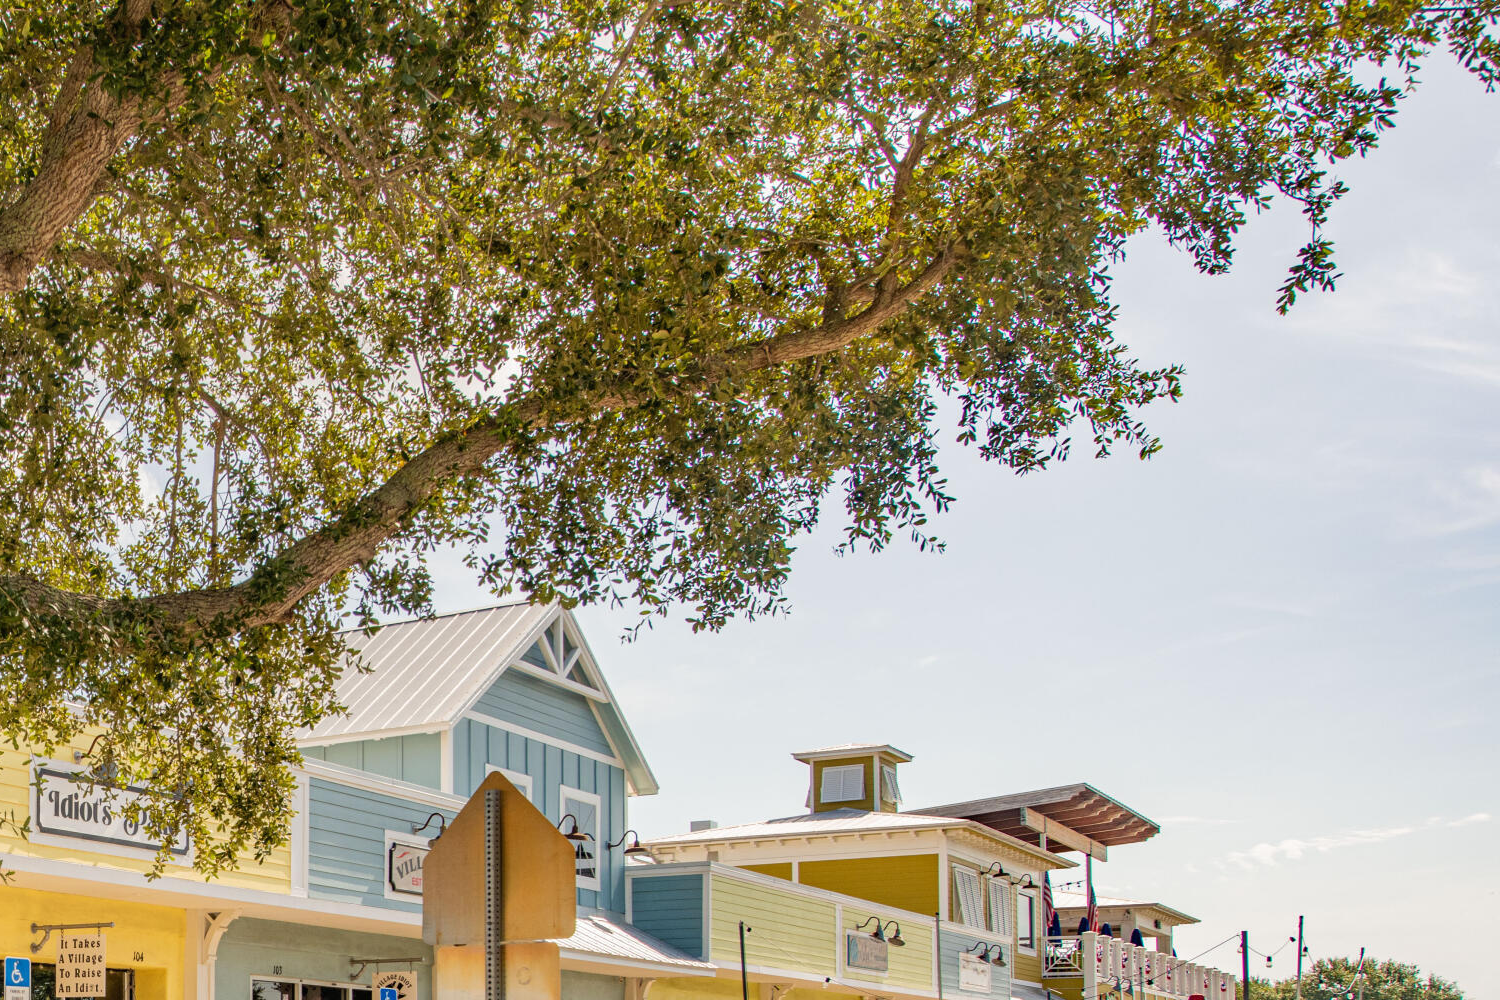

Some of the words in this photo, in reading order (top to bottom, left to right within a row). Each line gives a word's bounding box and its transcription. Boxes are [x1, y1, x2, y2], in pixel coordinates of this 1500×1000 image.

[48, 790, 112, 826] Idiot's
[395, 855, 424, 879] VILL
[60, 939, 68, 949] It
[72, 938, 101, 949] Takes
[58, 953, 65, 964] A
[68, 953, 103, 965] Village
[133, 951, 144, 962] 104
[59, 968, 71, 979] To
[74, 967, 102, 978] Raise
[272, 965, 283, 975] 103
[58, 983, 71, 993] An
[398, 975, 413, 989] IDIOT
